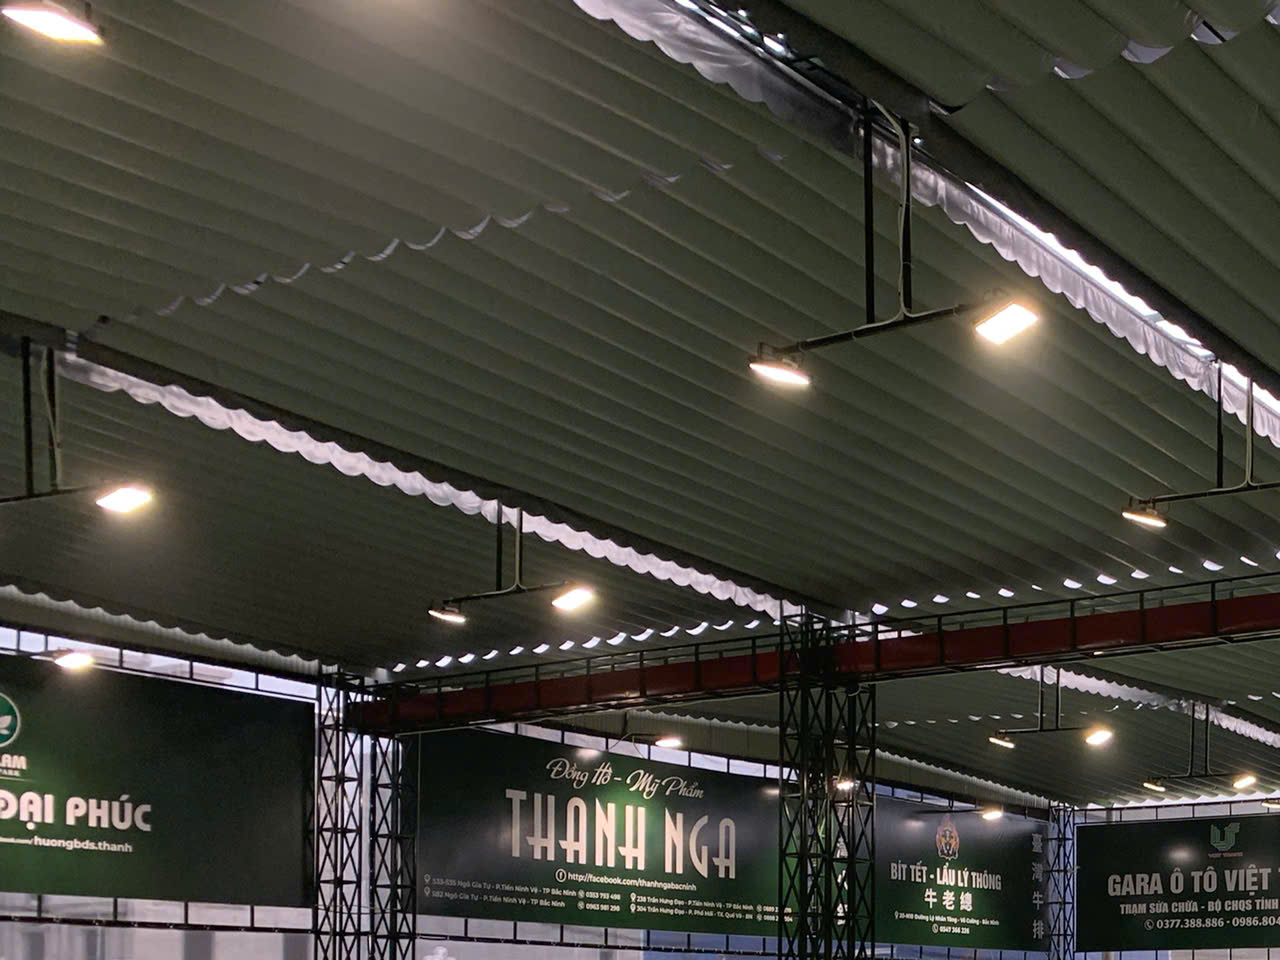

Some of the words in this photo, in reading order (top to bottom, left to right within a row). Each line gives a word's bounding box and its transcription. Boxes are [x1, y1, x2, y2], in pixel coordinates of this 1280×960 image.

[0, 754, 27, 770] AM
[546, 757, 588, 789] Đồng
[592, 762, 613, 785] Hồ
[626, 769, 661, 799] Mỹ
[662, 776, 704, 799] Phẩm
[65, 794, 152, 831] PHÚC
[506, 789, 646, 871] THANH
[665, 807, 736, 879] NGA
[891, 860, 907, 881] BÍT
[910, 861, 928, 883] TẾT
[936, 862, 956, 886] LẨU
[958, 867, 969, 888] LÝ
[971, 870, 1002, 890] THÔNG
[1108, 872, 1164, 897] GARA
[1170, 867, 1185, 895] Ô
[1192, 865, 1218, 894] TÔ
[1224, 863, 1272, 896] VIỆT
[1120, 903, 1147, 917] TRẠM
[1149, 899, 1169, 914] SỬA
[1171, 898, 1200, 913] CHỮA
[1207, 898, 1222, 915] BỘ
[1224, 899, 1253, 912] CHQS
[1156, 917, 1225, 929] 0377.388.886
